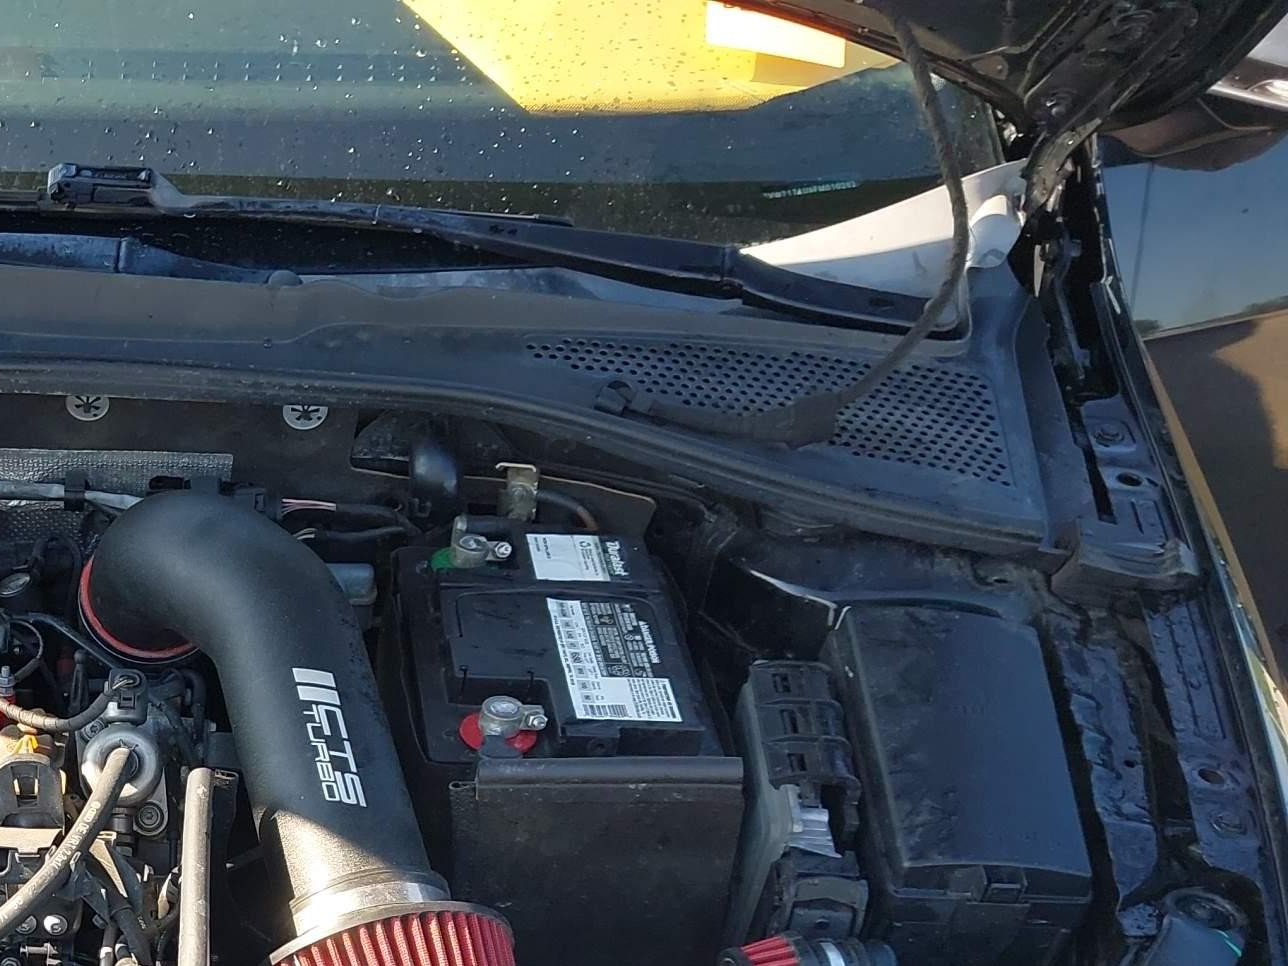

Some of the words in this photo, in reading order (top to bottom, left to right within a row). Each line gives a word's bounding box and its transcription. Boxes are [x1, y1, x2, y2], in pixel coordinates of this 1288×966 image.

[605, 540, 629, 577] Duralast
[303, 704, 341, 802] TURBO
[316, 705, 367, 808] CTS
